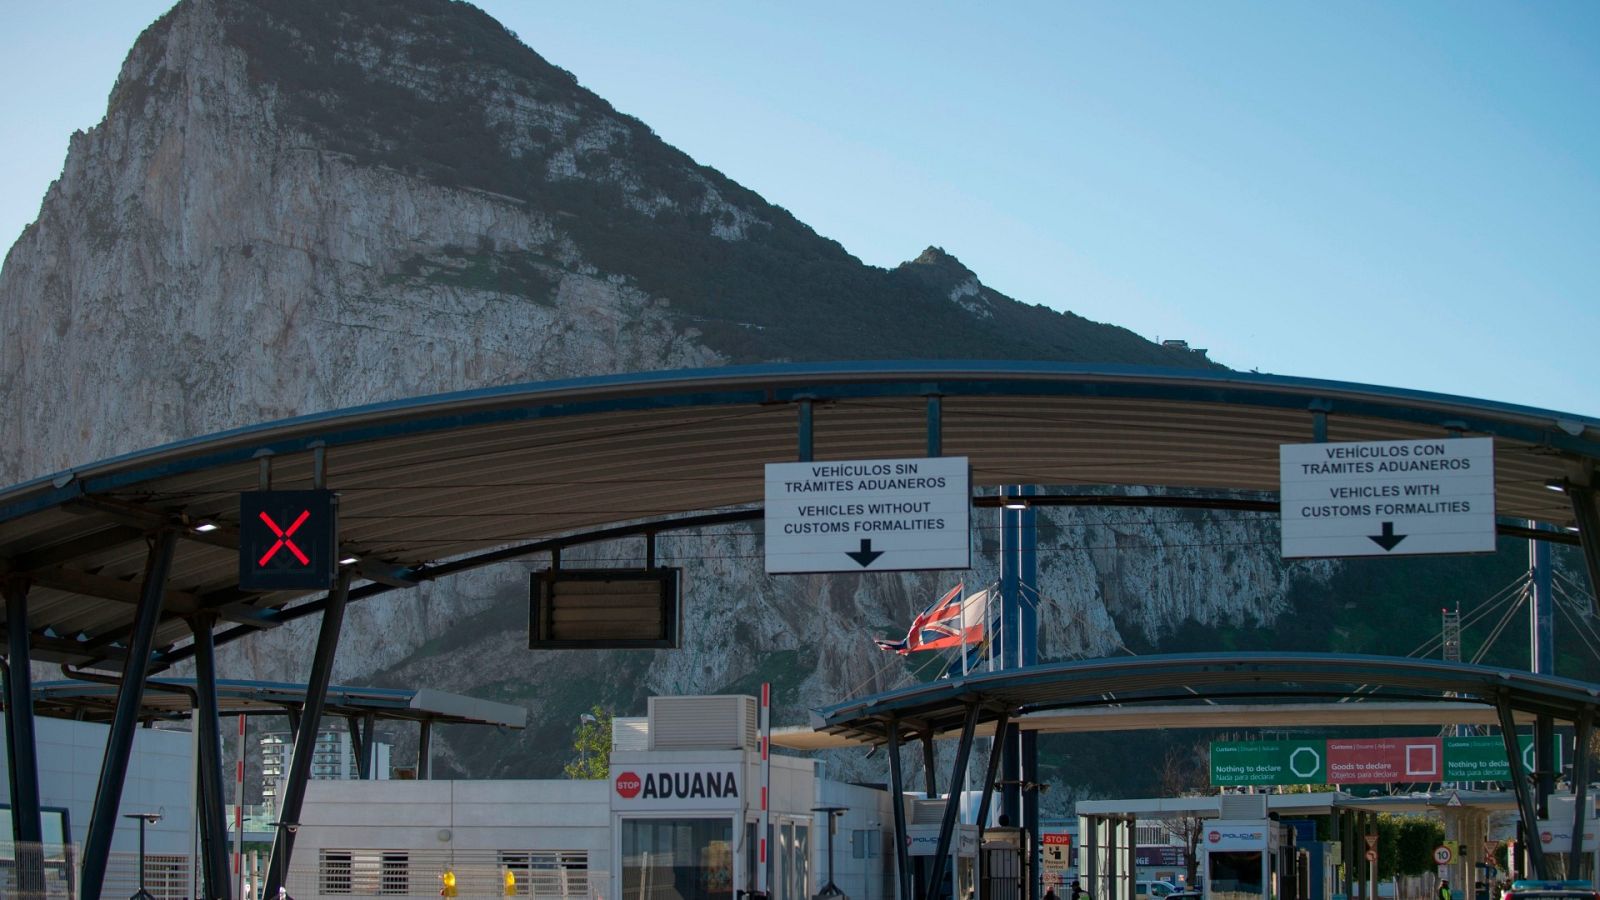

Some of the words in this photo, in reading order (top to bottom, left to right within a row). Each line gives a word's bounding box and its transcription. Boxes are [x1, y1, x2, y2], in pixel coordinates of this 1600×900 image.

[1326, 445, 1409, 459] VEHÍCULOS
[1413, 445, 1445, 456] CON
[812, 464, 891, 478] VEHÍCULOS
[895, 464, 918, 475] SIN
[1301, 461, 1374, 475] TRÁMITES
[1378, 458, 1471, 473] ADUANEROS
[785, 480, 854, 493] TRÁMITES
[858, 477, 946, 491] ADUANEROS
[1330, 486, 1400, 499] VEHICLES
[1404, 485, 1440, 496] WITH
[798, 504, 865, 517] VEHICLES
[868, 502, 931, 515] WITHOUT
[1301, 505, 1371, 518] CUSTOMS
[1375, 501, 1471, 515] FORMALITIES
[784, 522, 850, 534] CUSTOMS
[854, 518, 945, 532] FORMALITIES
[1216, 765, 1244, 773] Nothing
[1448, 760, 1477, 769] Nothing
[1488, 760, 1509, 768] decla
[1250, 773, 1275, 781] declarar
[617, 782, 640, 790] STOP
[642, 772, 739, 799] ADUANA
